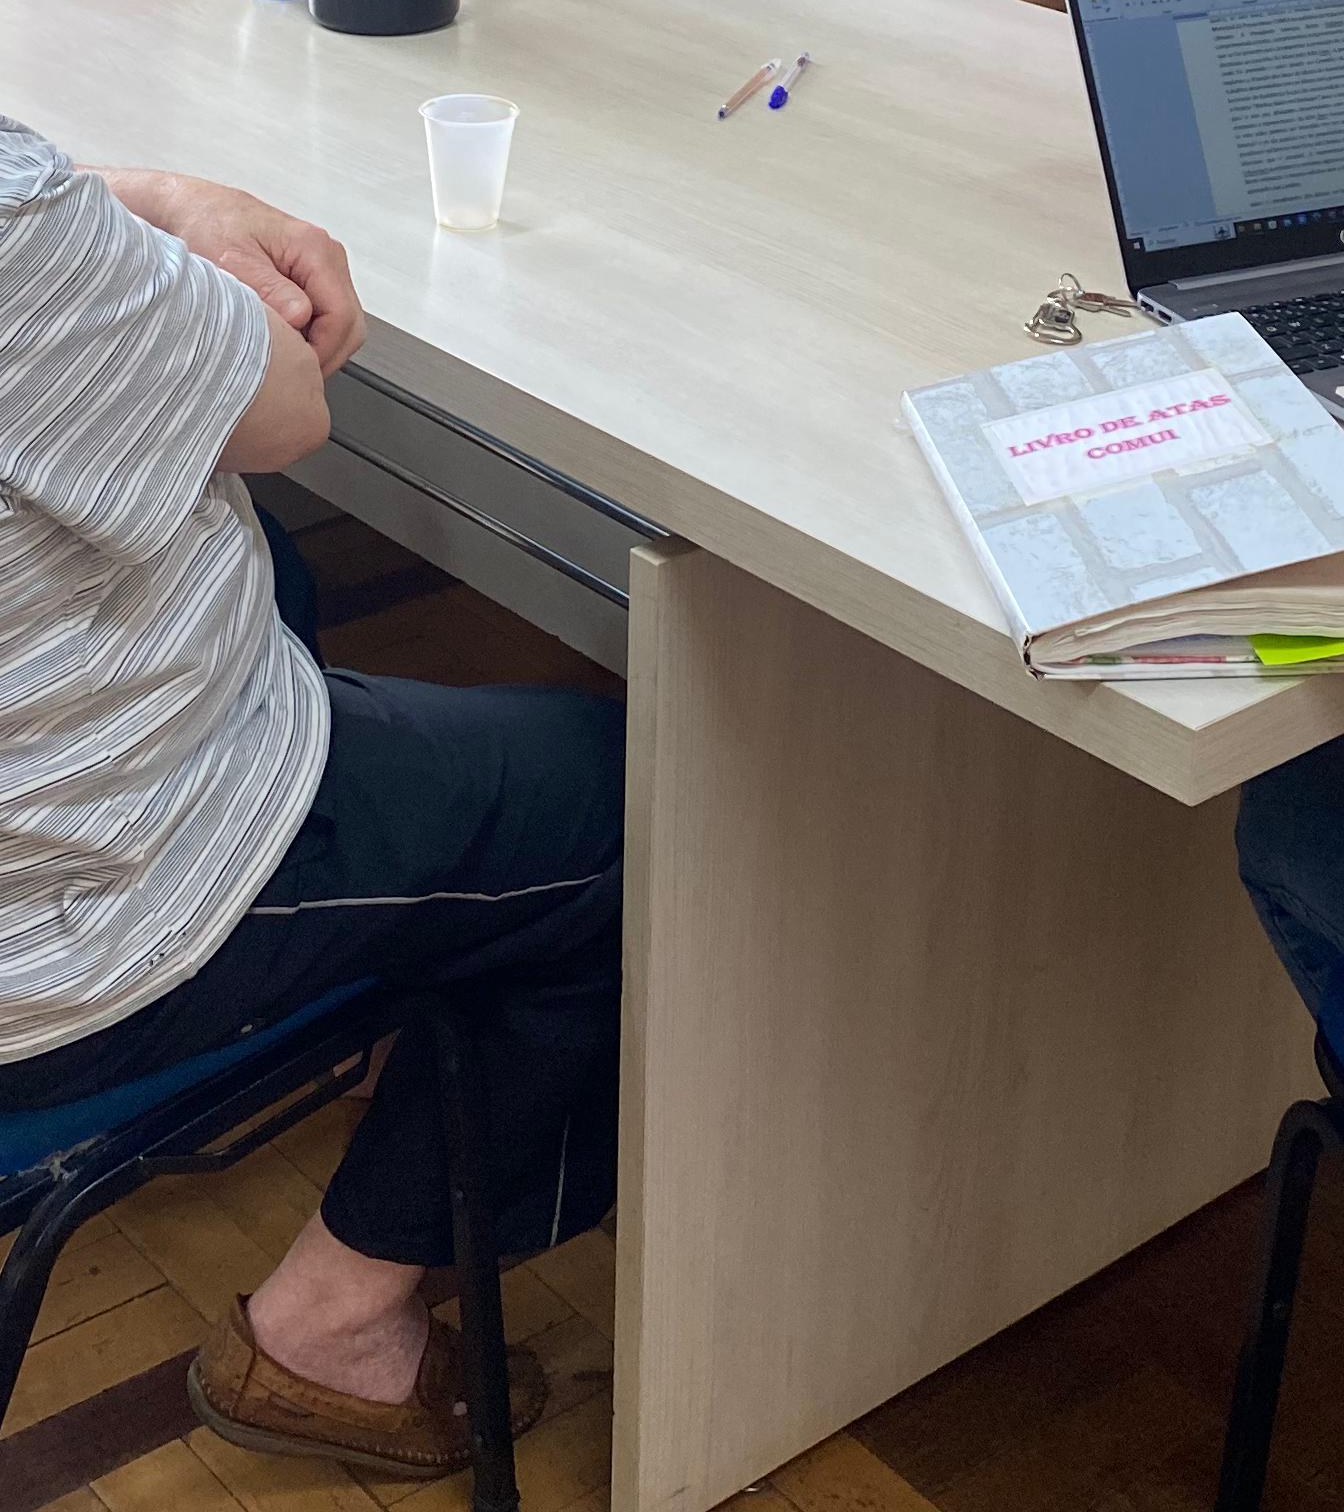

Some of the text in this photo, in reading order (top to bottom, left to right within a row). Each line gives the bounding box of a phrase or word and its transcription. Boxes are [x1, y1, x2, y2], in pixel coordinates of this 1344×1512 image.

[1008, 394, 1233, 457] LIVRO DE ATAS
[1086, 428, 1181, 459] COMUI
